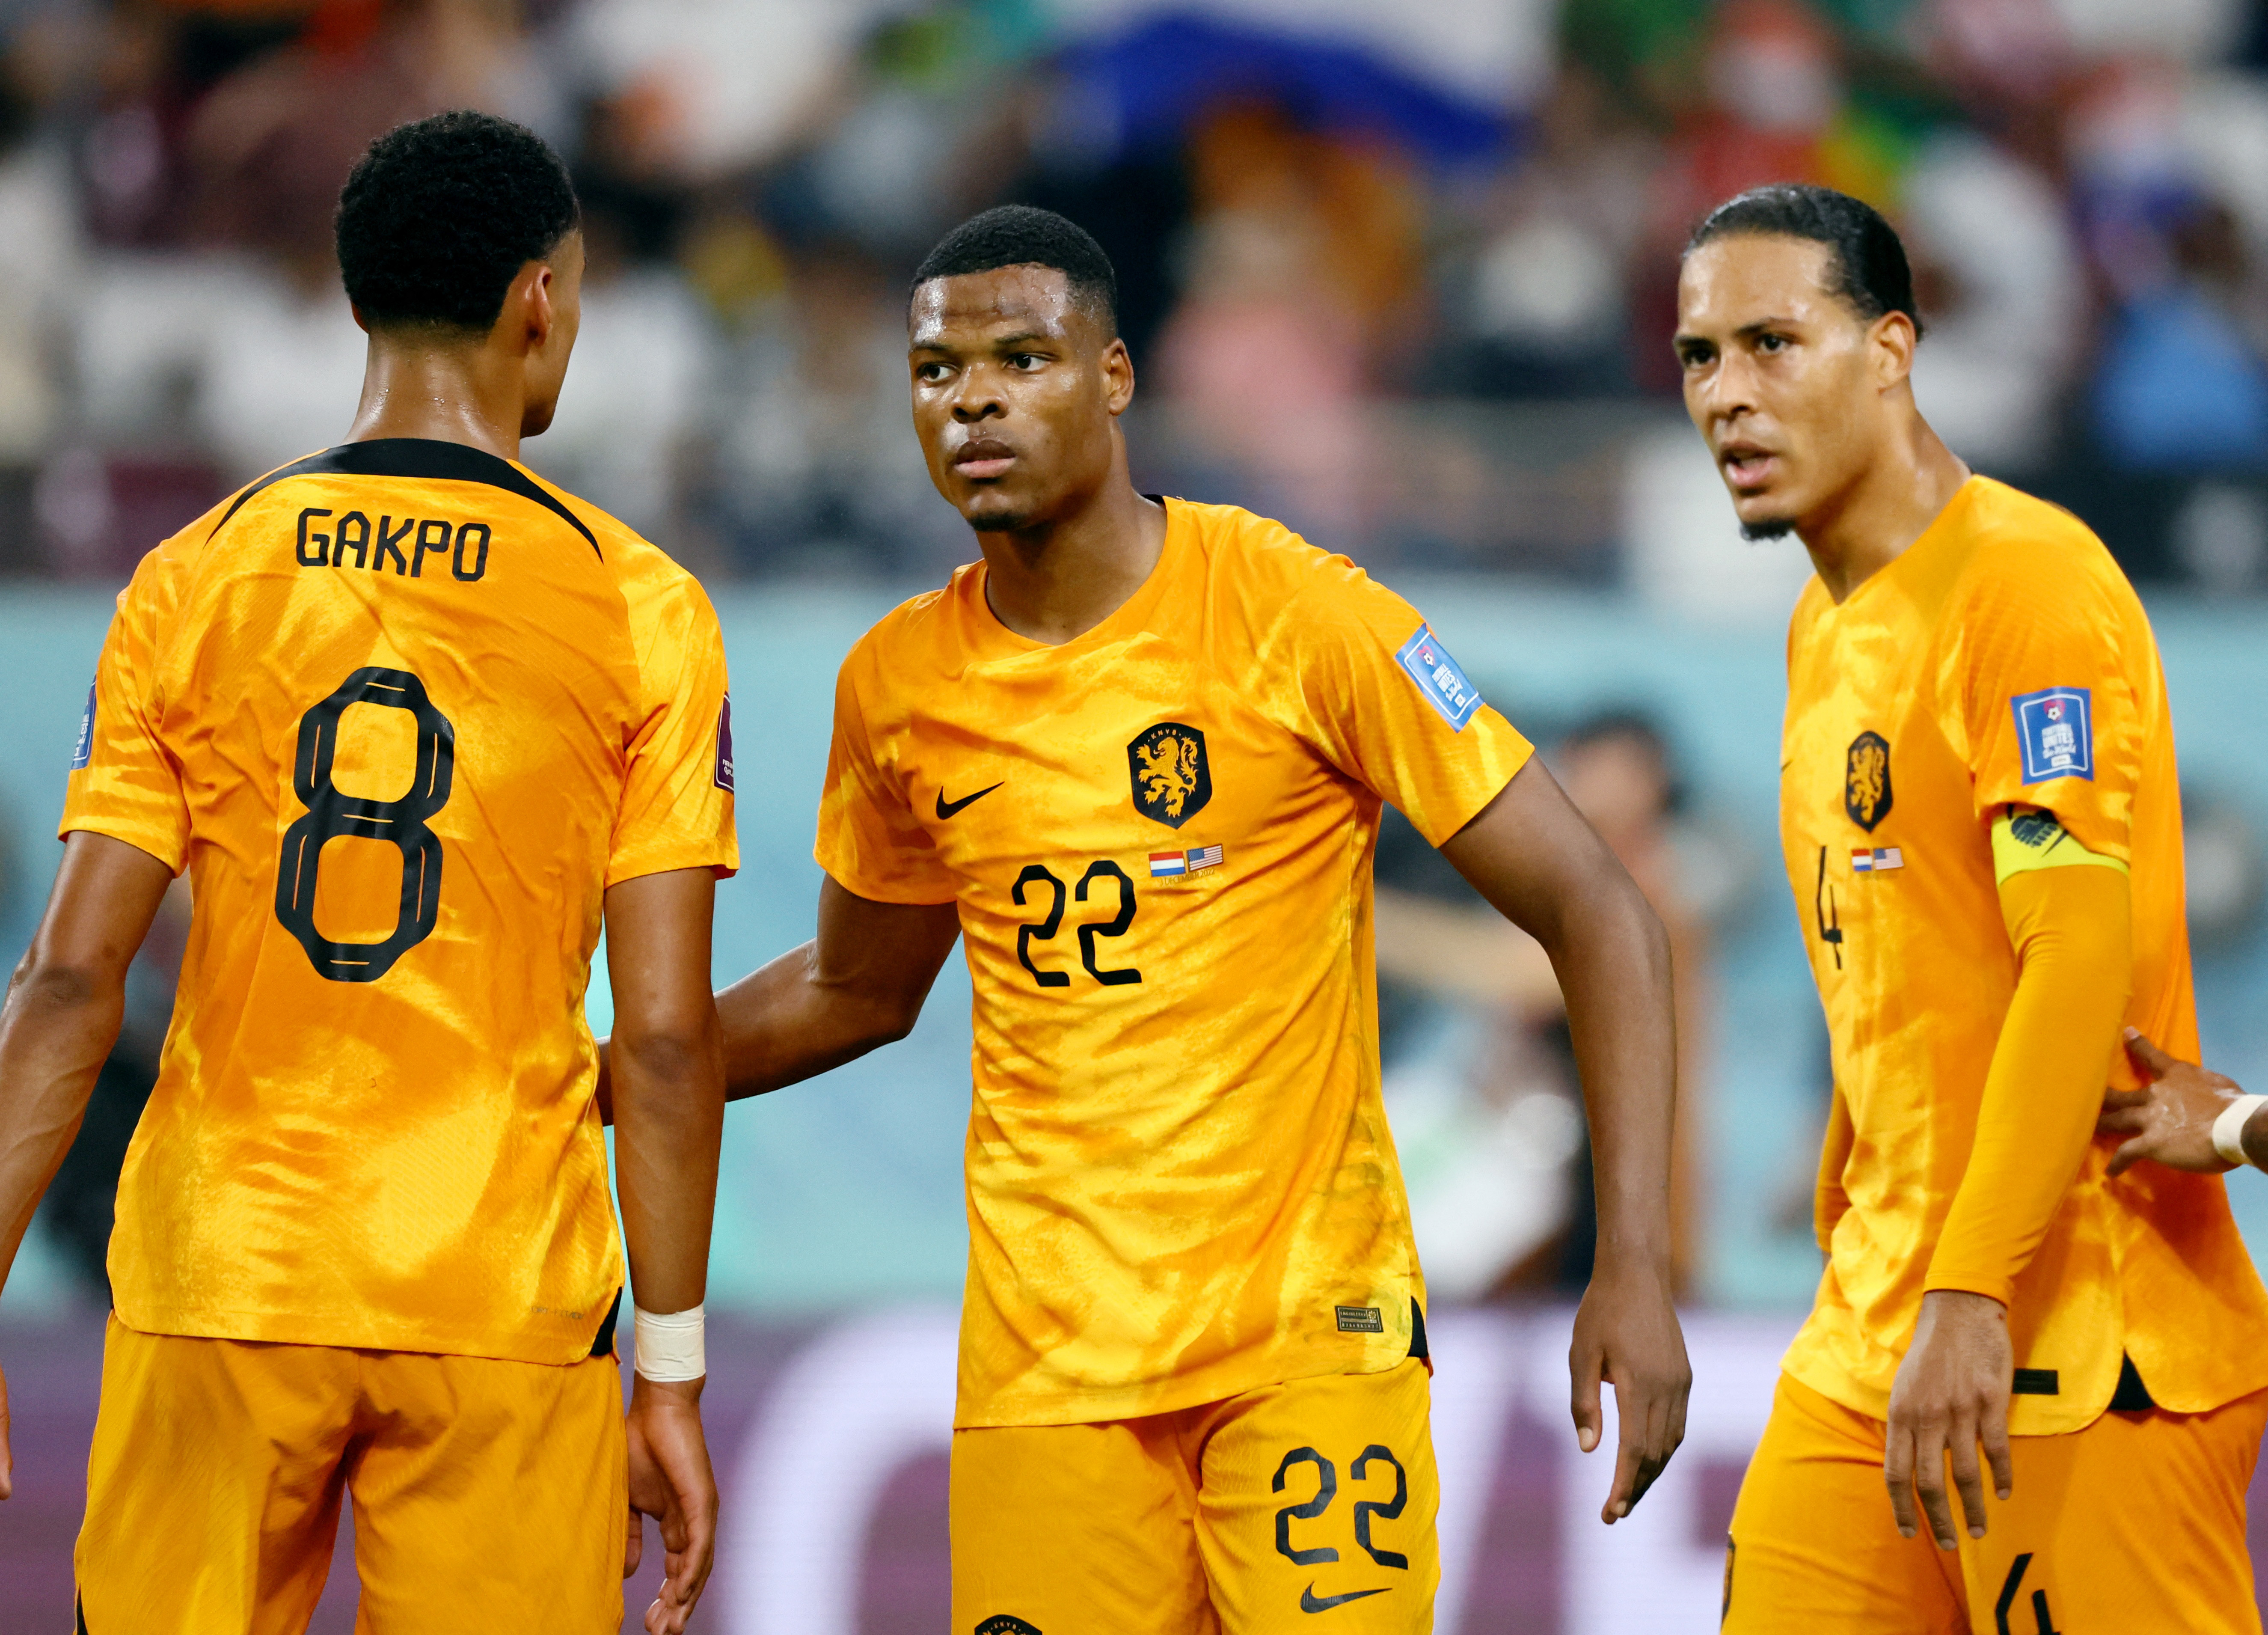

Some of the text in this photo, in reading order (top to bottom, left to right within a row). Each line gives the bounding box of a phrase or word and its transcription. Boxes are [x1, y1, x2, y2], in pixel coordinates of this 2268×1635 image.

[297, 508, 491, 582] GAKPO
[275, 666, 454, 982] 8
[1200, 868, 1216, 878] 2022
[1012, 860, 1142, 987] 22
[1817, 846, 1843, 970] 4
[1272, 1445, 1408, 1570] 22
[1995, 1553, 2061, 1635] 4
